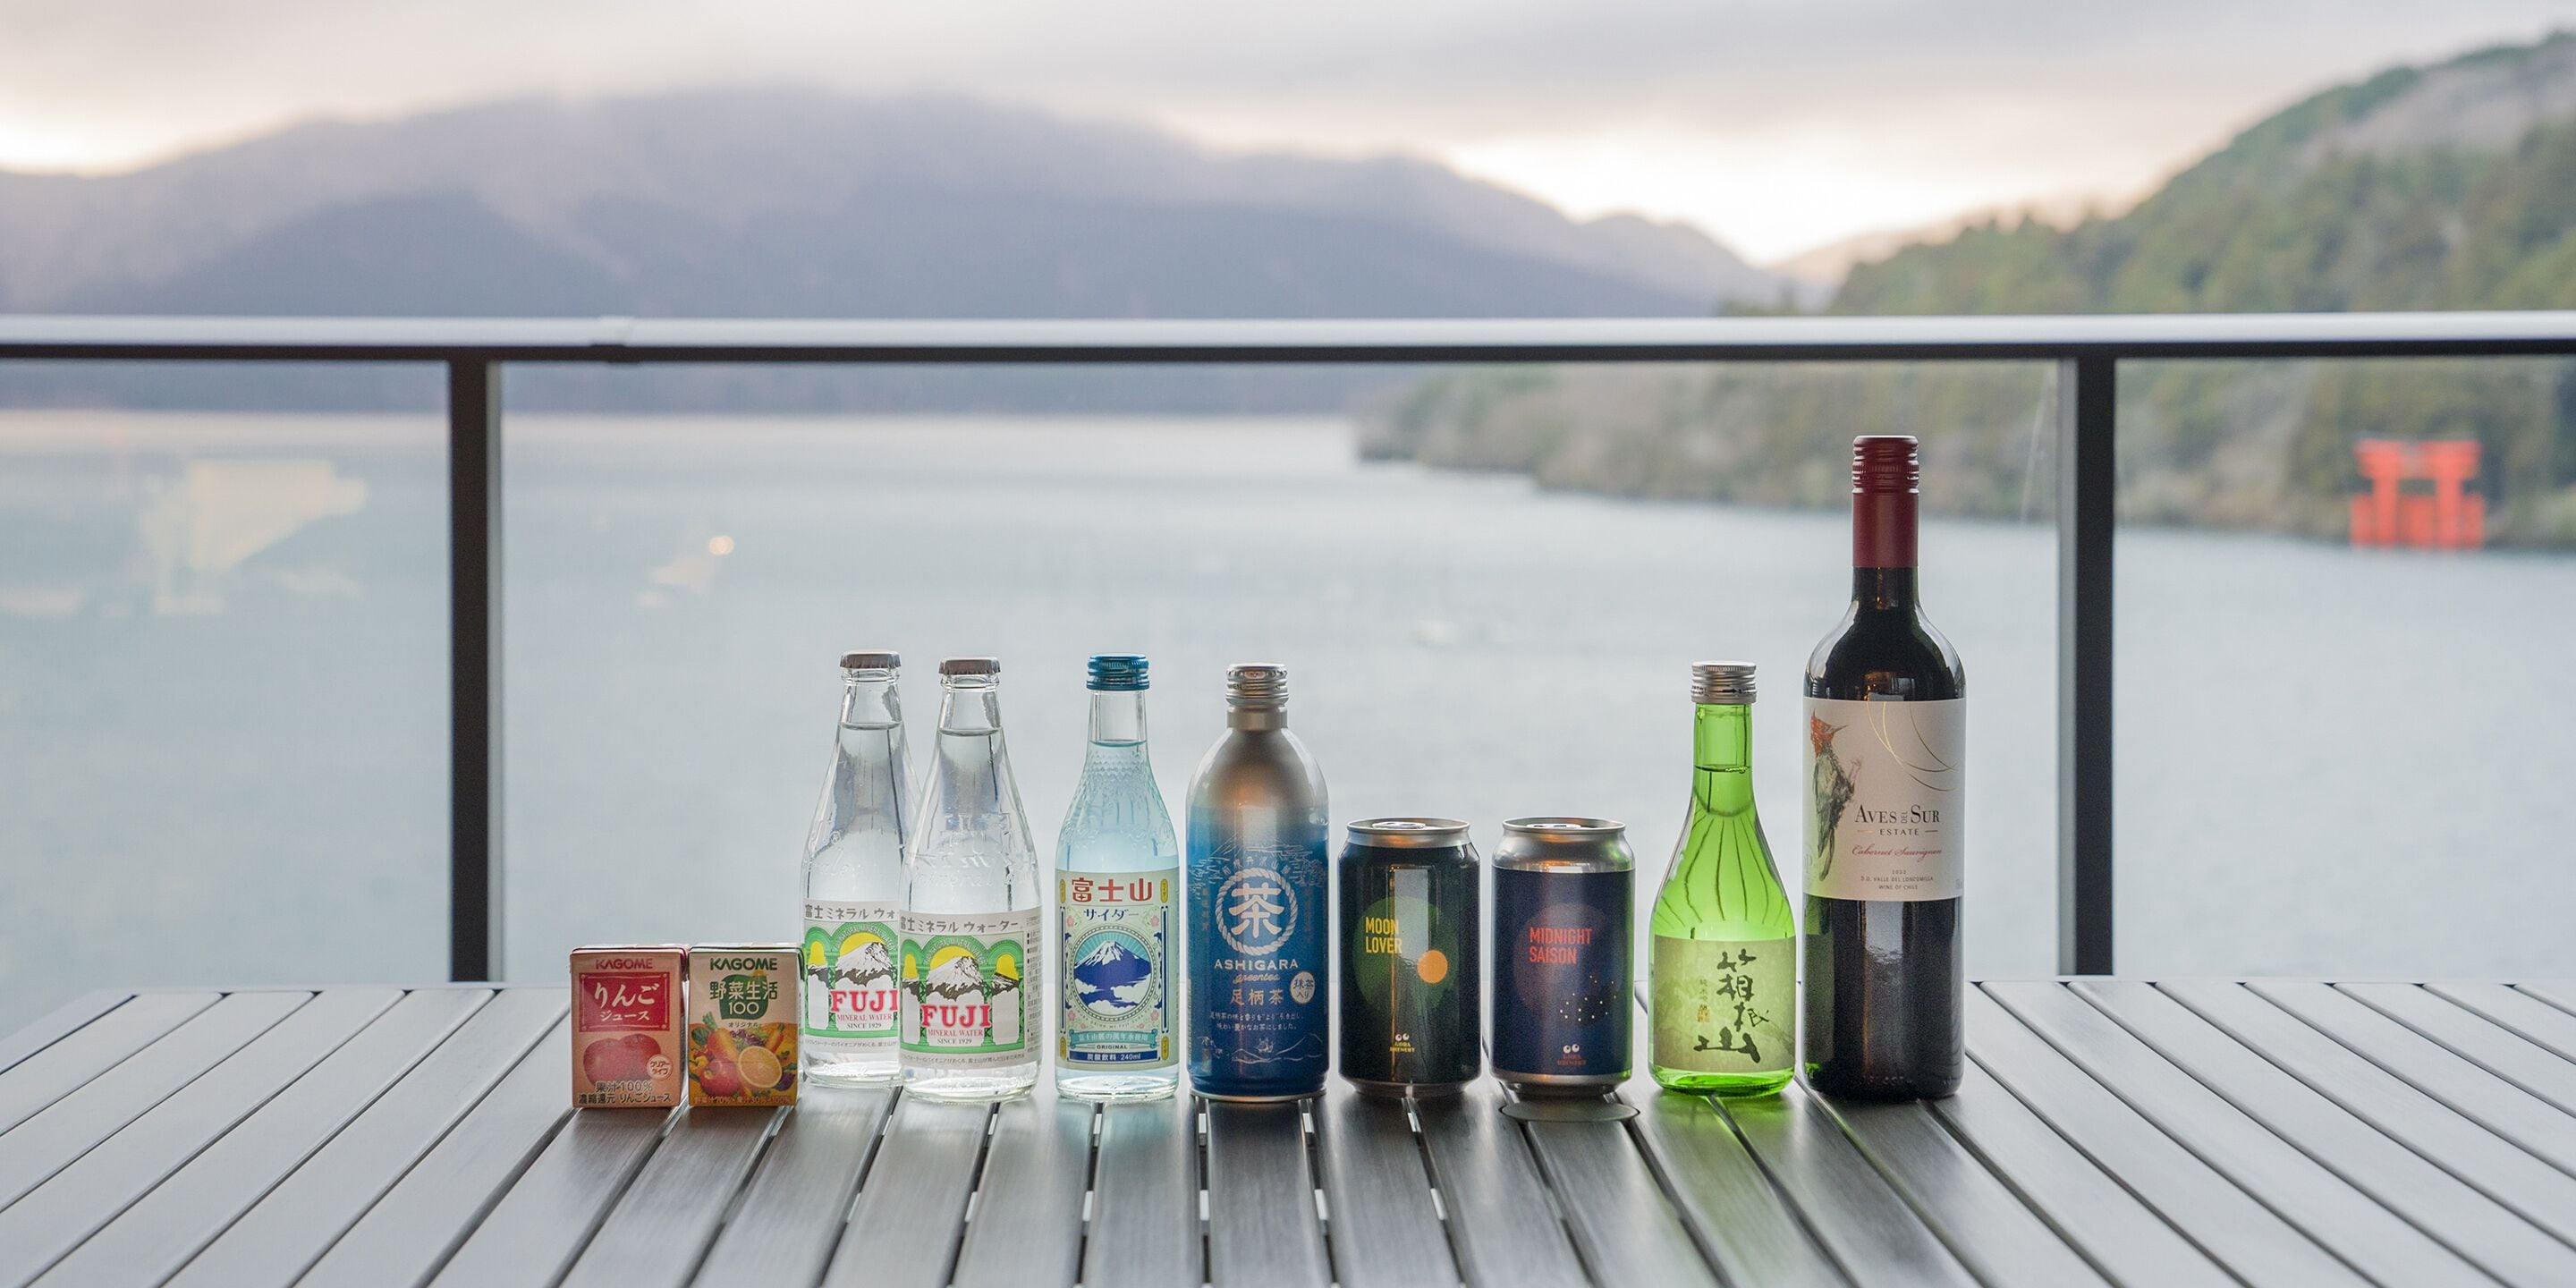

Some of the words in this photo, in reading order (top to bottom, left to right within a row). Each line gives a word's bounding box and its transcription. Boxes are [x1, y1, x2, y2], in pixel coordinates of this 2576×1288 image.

[1855, 804, 1897, 823] AVES
[1911, 804, 1940, 823] SUR
[1852, 843, 1894, 855] Cabernet
[1894, 846, 1942, 862] Sauvignon
[1072, 877, 1153, 902] 富士山
[1084, 908, 1139, 922] サイダー
[1229, 882, 1284, 938] 茶
[1365, 917, 1400, 935] MOON
[1530, 927, 1592, 945] MIDNIGHT
[1365, 936, 1402, 954] LOVER
[710, 958, 778, 970] KAGOME
[1530, 947, 1577, 964] SAISON
[596, 959, 654, 970] KAGOME
[1214, 959, 1299, 970] ASHIGARA
[709, 980, 778, 1001] 野菜生活
[1293, 979, 1314, 990] 抹茶
[594, 982, 660, 1008] りんご
[830, 988, 897, 1013] FUJI
[1230, 988, 1284, 1006] 足柄茶
[1297, 991, 1309, 999] 入り
[728, 1002, 759, 1015] 100
[1693, 948, 1770, 1063] 箱根山
[600, 1010, 650, 1021] ジュース
[837, 1013, 868, 1021] MINERAL
[869, 1013, 892, 1021] WATER
[921, 1004, 991, 1028] FUJI
[928, 1029, 957, 1037] MINERAL
[959, 1029, 983, 1037] WATER
[1087, 1053, 1117, 1061] 炭酸飲料
[1120, 1053, 1141, 1061] 240ml
[619, 1092, 672, 1104] りんごジュース
